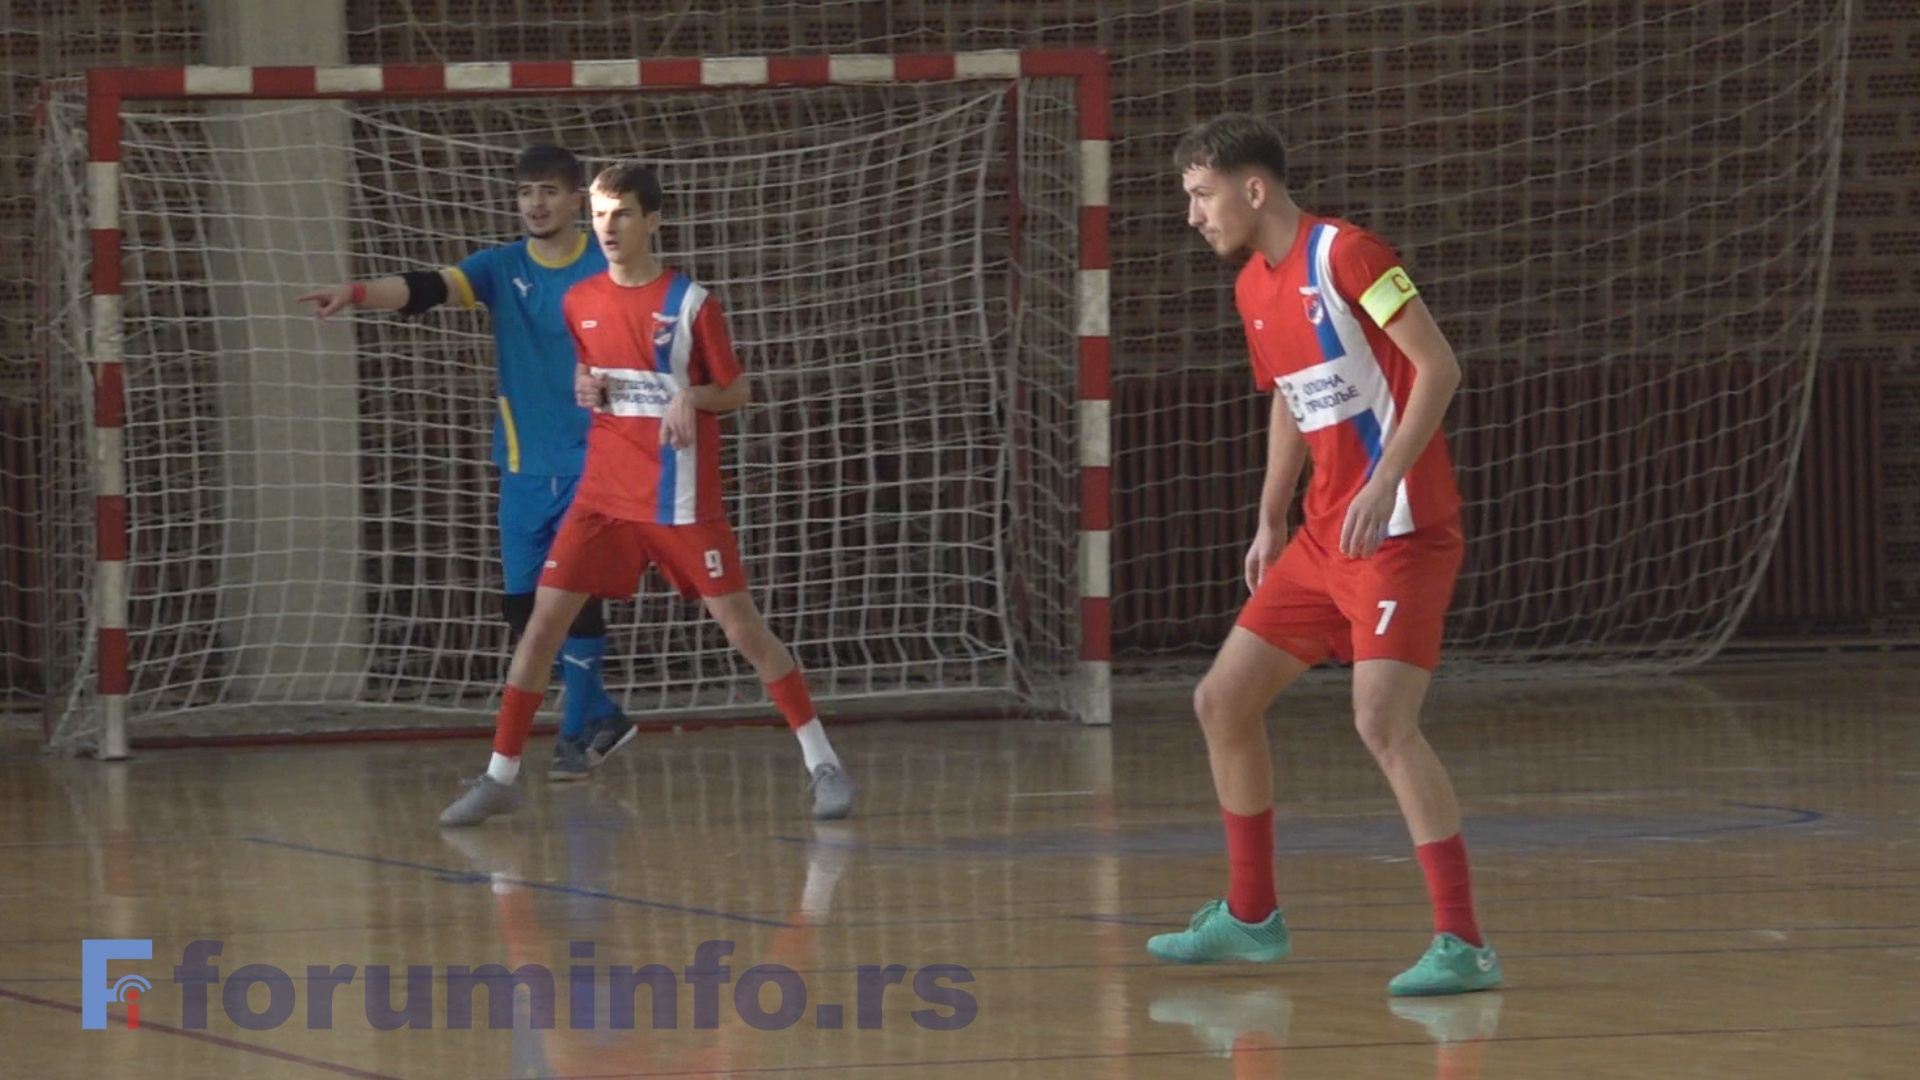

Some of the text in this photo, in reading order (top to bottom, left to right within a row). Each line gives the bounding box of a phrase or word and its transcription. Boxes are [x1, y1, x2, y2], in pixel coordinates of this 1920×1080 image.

[1391, 274, 1412, 293] C
[704, 549, 724, 579] 9
[1374, 599, 1398, 635] 7
